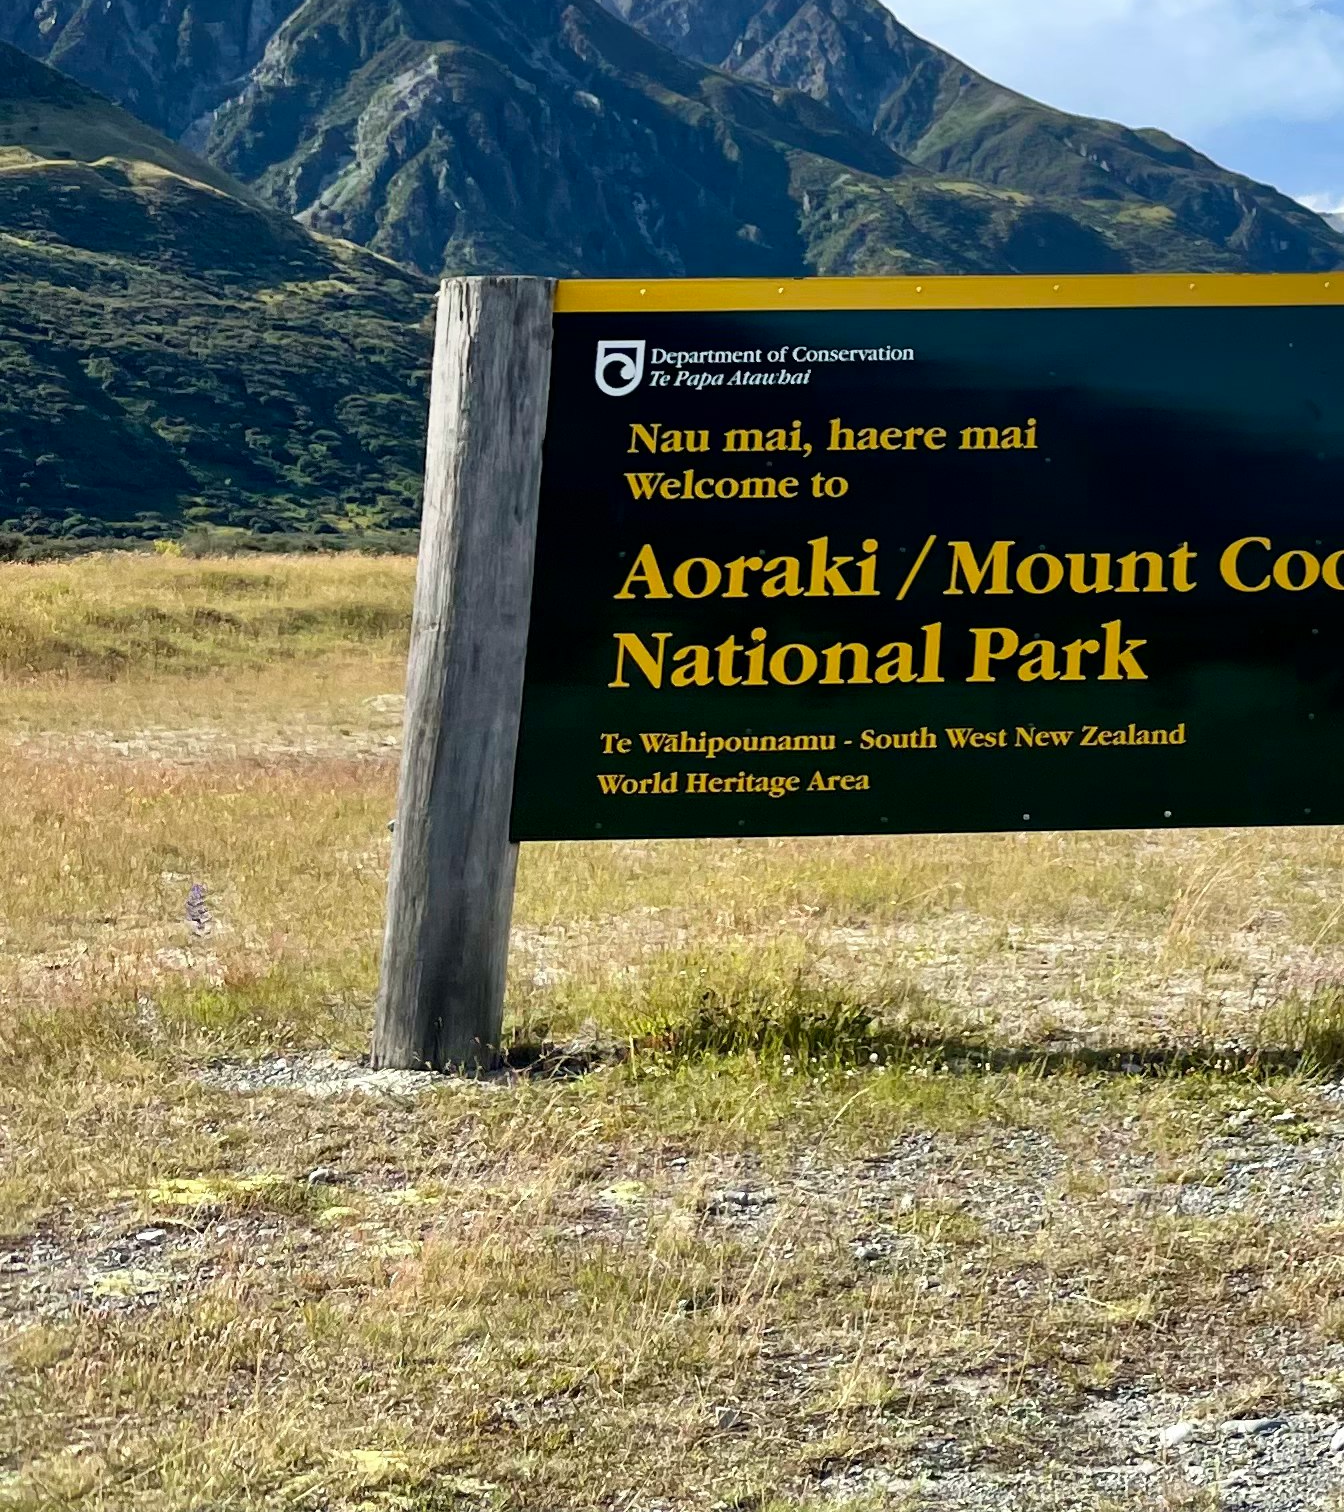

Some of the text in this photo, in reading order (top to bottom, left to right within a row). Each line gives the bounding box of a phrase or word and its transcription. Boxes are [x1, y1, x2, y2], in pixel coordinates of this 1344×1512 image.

[651, 345, 915, 369] Department of Conservation
[649, 369, 812, 391] Te Papa Atawhai
[627, 418, 1038, 458] Nau mai, haere mai
[624, 469, 849, 500] Welcome to
[613, 536, 880, 600] Aoraki
[943, 540, 1198, 595] Mount
[608, 619, 1149, 689] National Park
[600, 732, 632, 754] Te
[639, 731, 837, 759] Wāhipounamu
[859, 727, 938, 750] South
[945, 727, 1007, 749] West
[1014, 726, 1075, 748] New
[1080, 722, 1187, 746] Zealand
[596, 770, 871, 798] World Heritage Area
